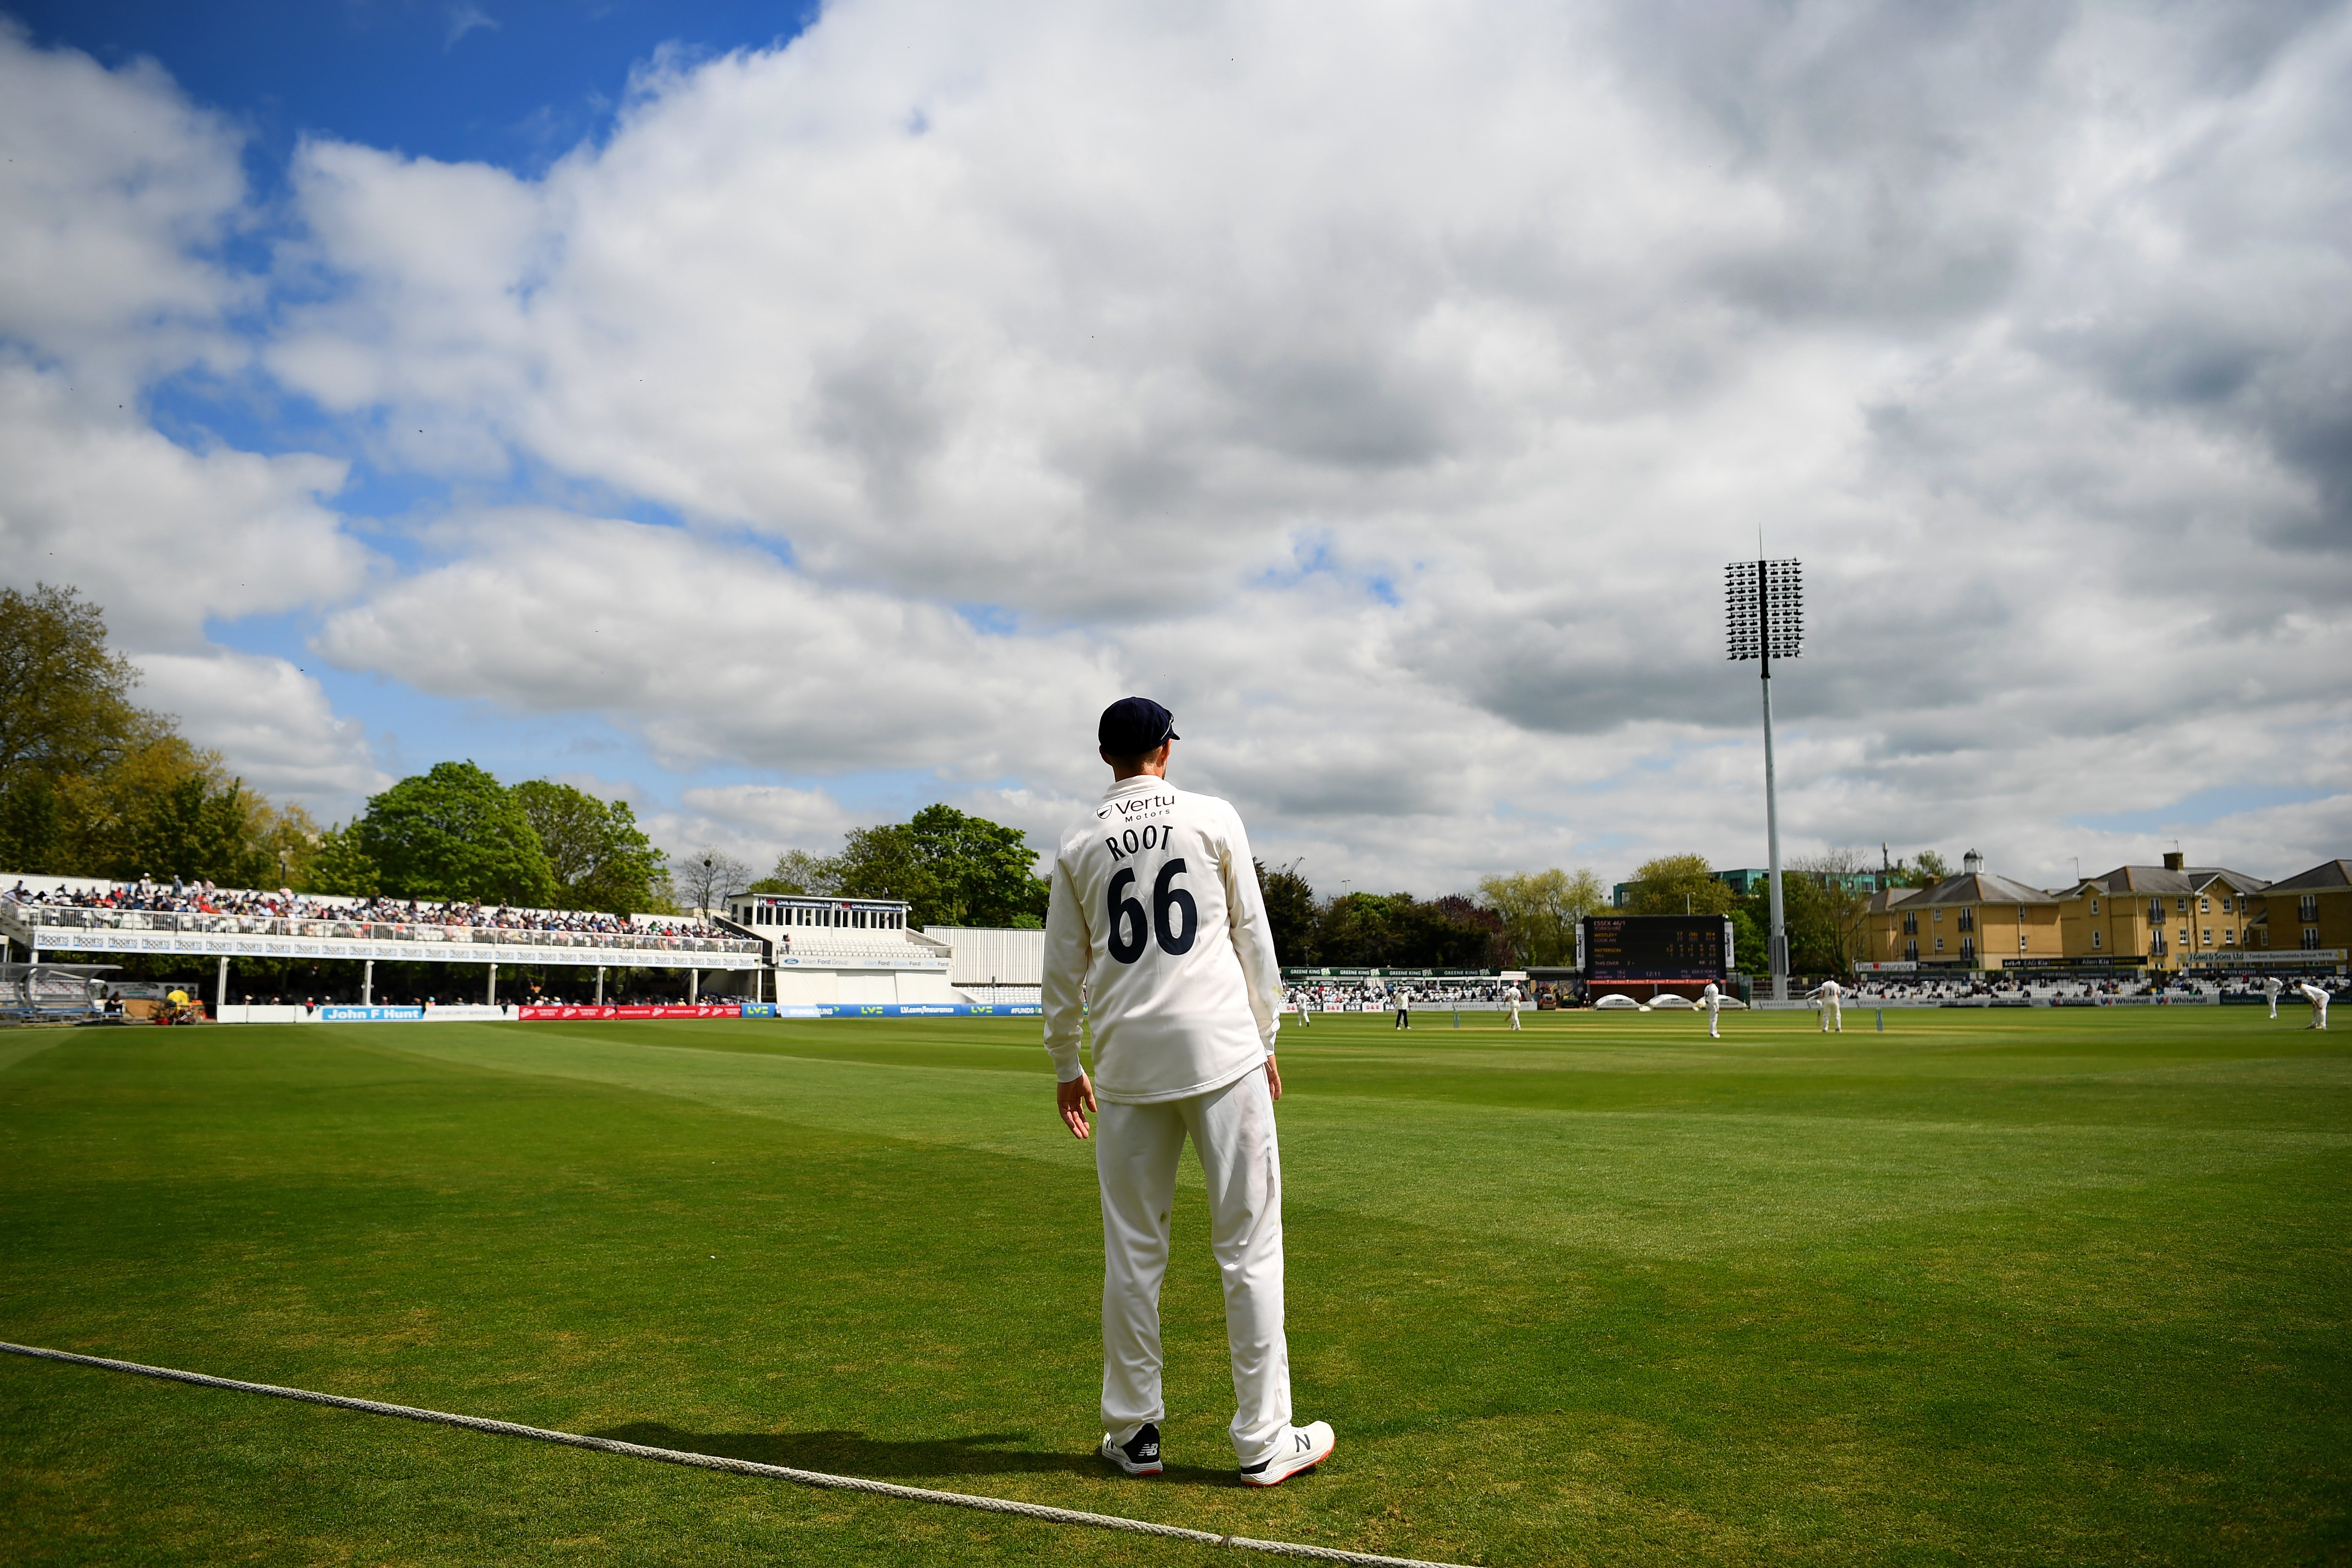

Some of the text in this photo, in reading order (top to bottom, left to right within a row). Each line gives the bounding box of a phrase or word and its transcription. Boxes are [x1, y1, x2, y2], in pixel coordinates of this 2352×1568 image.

[1115, 795, 1174, 814] Vertu
[1125, 809, 1170, 822] Motors
[1105, 825, 1173, 861] ROOT
[1107, 858, 1198, 964] 66
[37, 933, 69, 946] Higgins
[73, 934, 103, 947] Higgins
[108, 936, 138, 948] Higgins
[142, 936, 170, 950] Higgins
[1321, 967, 1331, 975] IPA
[1880, 962, 1914, 970] Insurance
[2115, 997, 2151, 1005] Whitehall
[2172, 996, 2208, 1004] Whitehall
[328, 1009, 419, 1019] John F Hunt
[900, 1005, 954, 1014] LV.com/insurance
[1295, 1434, 1311, 1453] N
